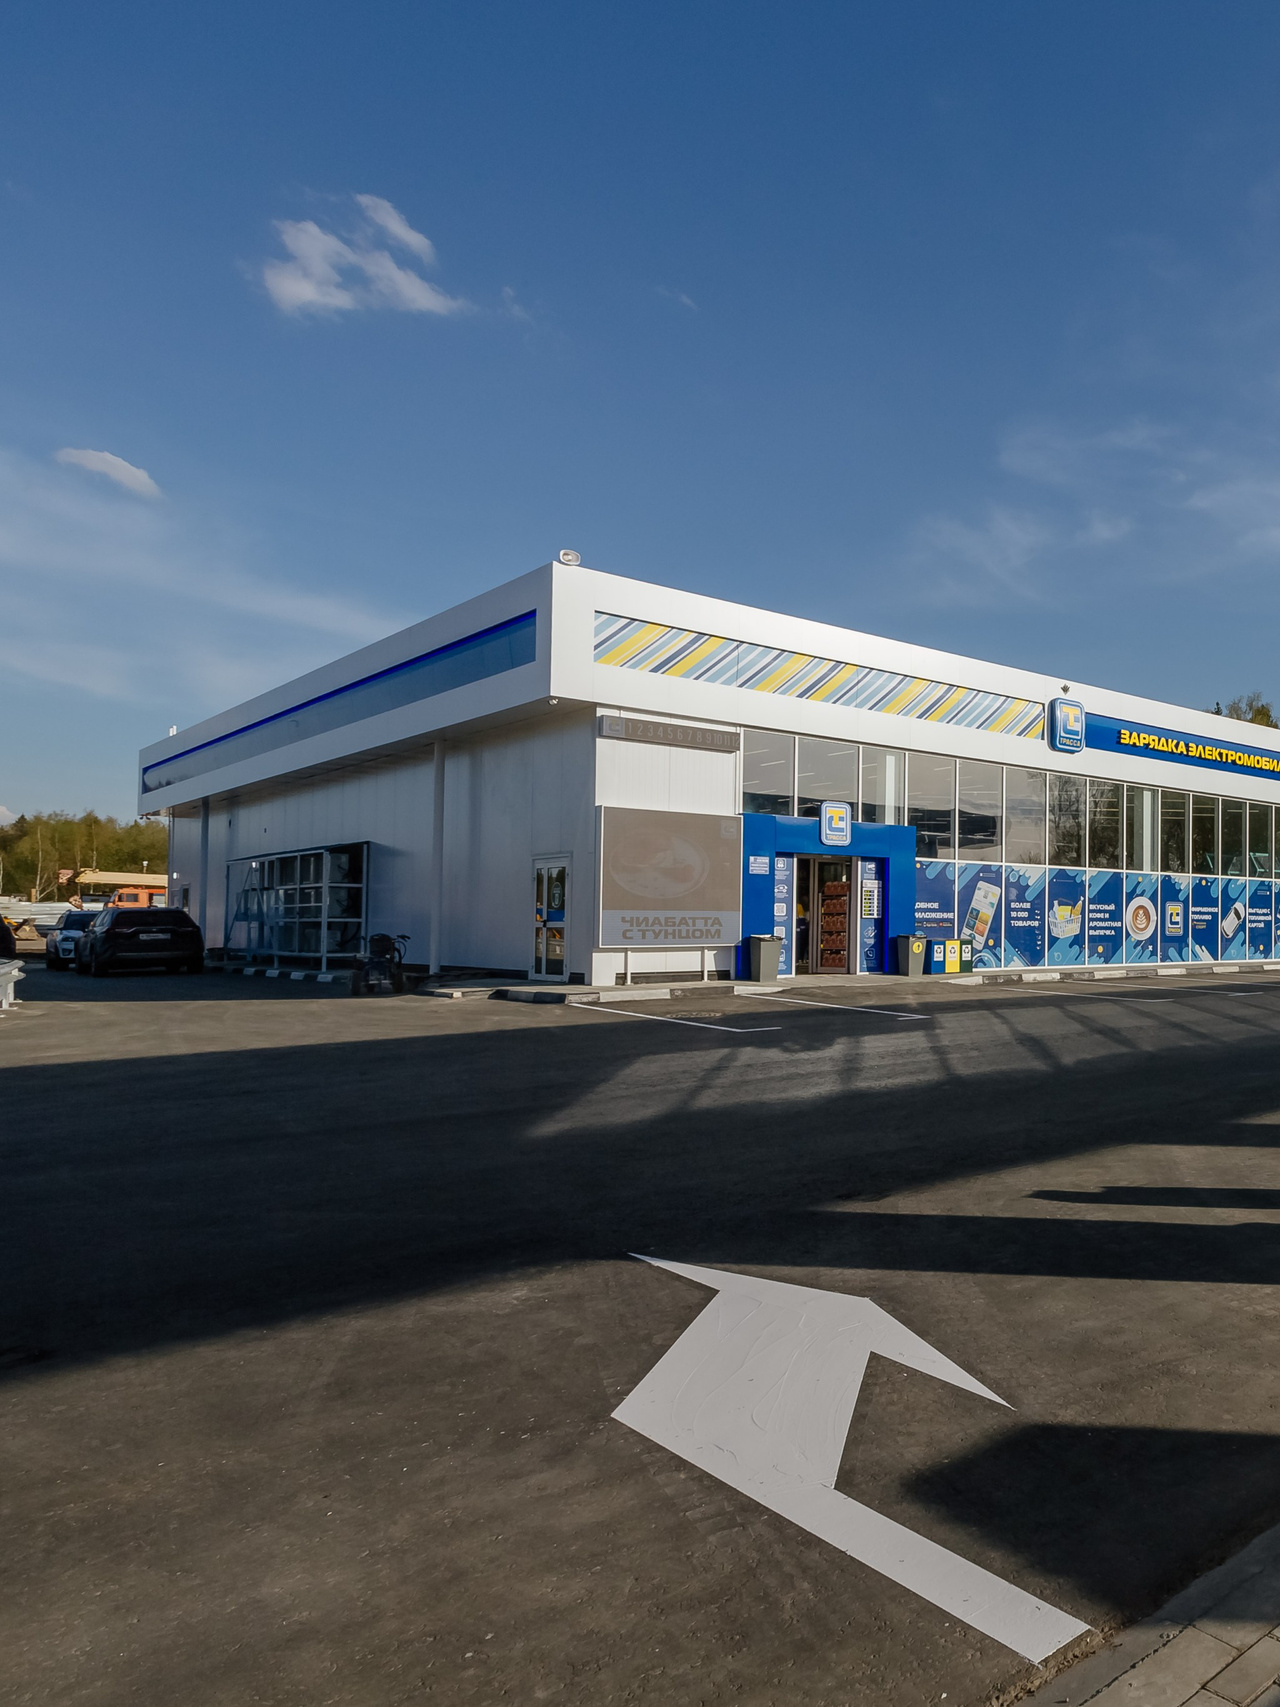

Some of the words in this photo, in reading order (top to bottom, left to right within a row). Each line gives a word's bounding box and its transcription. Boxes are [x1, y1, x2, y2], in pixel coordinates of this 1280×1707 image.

[628, 722, 632, 733] 1
[637, 723, 643, 735] 2
[648, 725, 653, 736] 3
[657, 726, 663, 737] 4
[668, 727, 673, 739] 5
[677, 729, 683, 740] 6
[687, 730, 693, 741] 7
[697, 731, 702, 742] 8
[706, 732, 712, 744] 9
[714, 734, 722, 744] 10
[724, 735, 730, 746] 11
[732, 736, 740, 747] 12
[1060, 737, 1081, 748] ТРАССА
[1120, 729, 1187, 755] ЗАРЯДКА
[620, 916, 723, 928] ЧИАБАТТА
[622, 928, 634, 940] С
[638, 928, 721, 940] ТУНЦОМ
